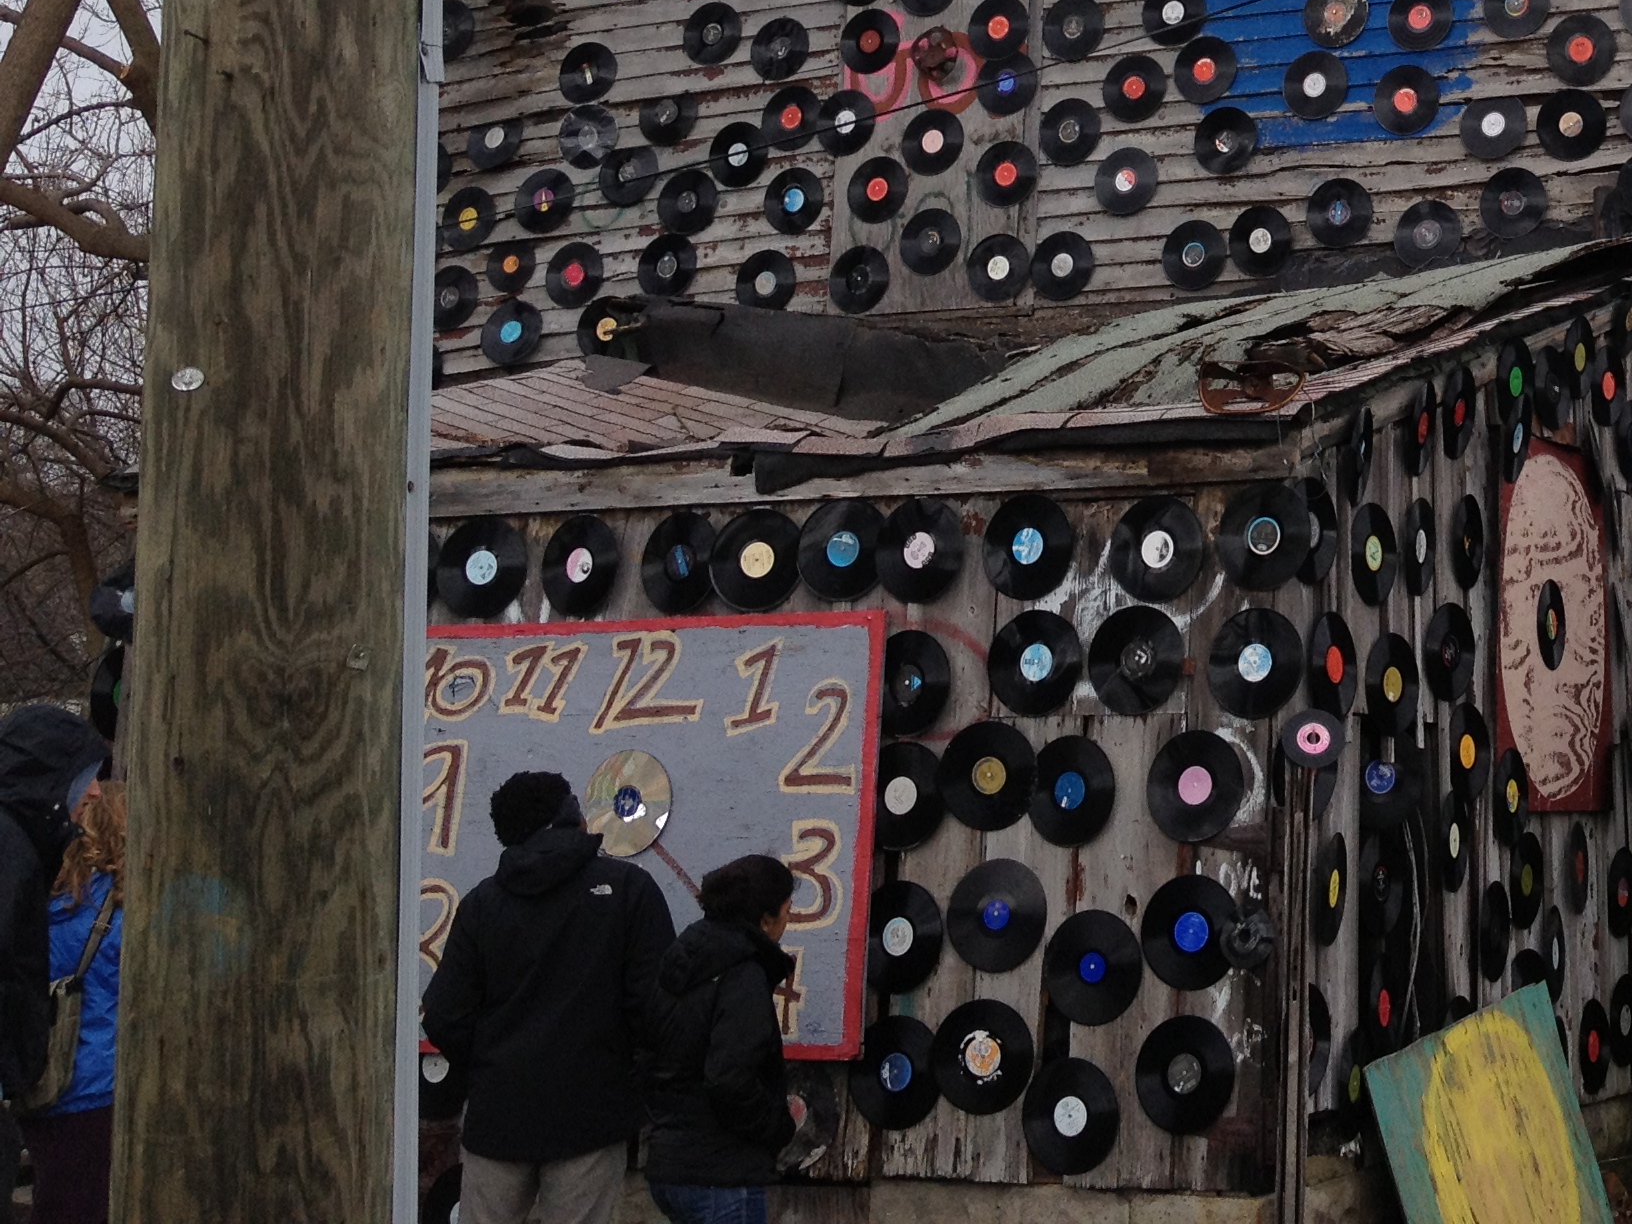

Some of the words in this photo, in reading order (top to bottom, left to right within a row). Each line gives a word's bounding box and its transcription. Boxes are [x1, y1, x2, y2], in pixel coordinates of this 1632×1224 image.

[502, 643, 584, 718] 11
[591, 634, 700, 731] 12
[728, 640, 780, 732] 1
[780, 682, 854, 790] 2
[785, 823, 839, 927] 3
